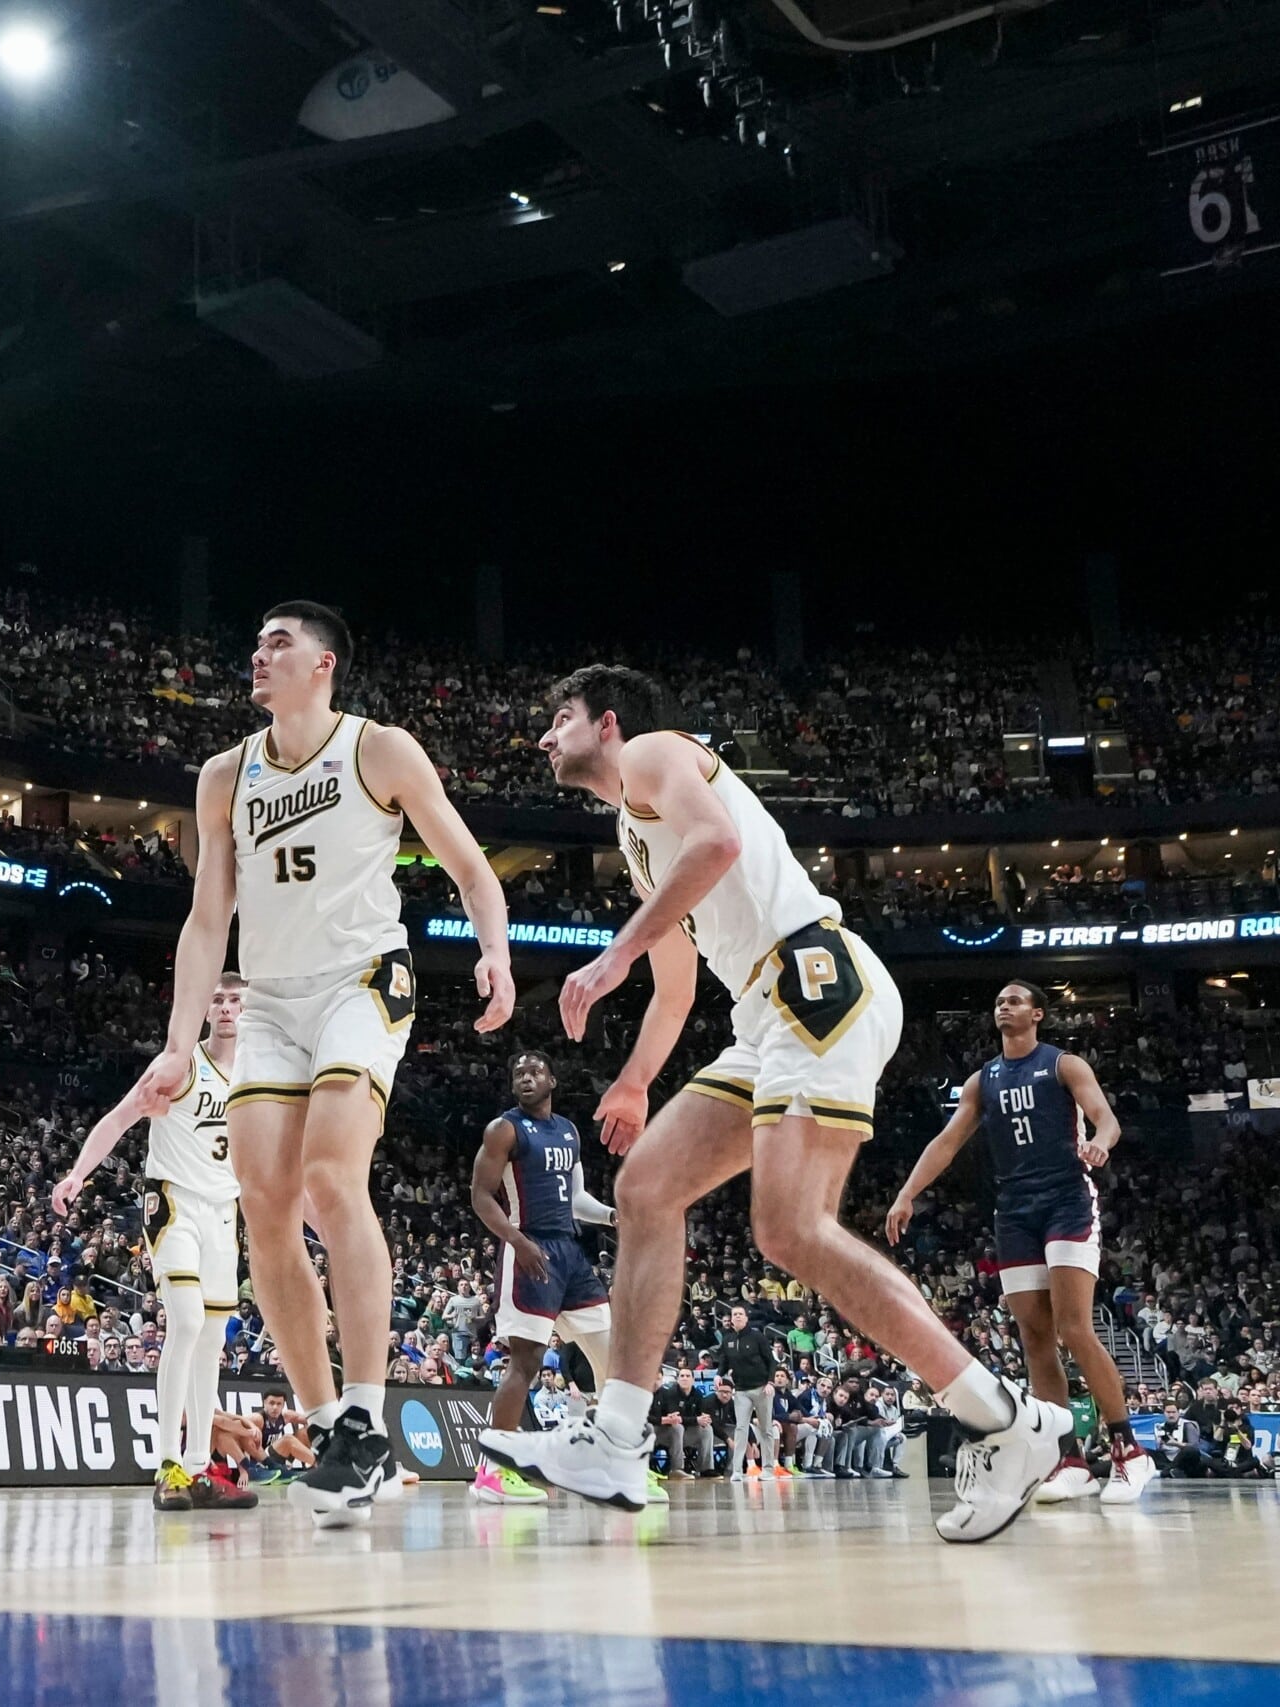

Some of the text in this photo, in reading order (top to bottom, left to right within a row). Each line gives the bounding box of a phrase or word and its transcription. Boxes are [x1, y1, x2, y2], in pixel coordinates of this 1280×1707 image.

[1190, 157, 1261, 244] 61
[246, 777, 342, 837] Purdue
[274, 845, 317, 884] 15
[427, 919, 613, 946] #MAHMADNESS
[1048, 926, 1117, 946] FIRST
[1141, 921, 1235, 944] SECOND
[1240, 916, 1280, 938] ROU
[41, 947, 56, 960] C7
[793, 946, 839, 1001] P
[1144, 984, 1170, 996] C10
[57, 1071, 81, 1088] 106
[194, 1091, 227, 1119] Pur
[999, 1085, 1036, 1115] FDU
[1011, 1116, 1035, 1146] 21
[544, 1147, 574, 1171] FDU
[556, 1174, 569, 1202] 2
[144, 1191, 160, 1226] P
[53, 1339, 80, 1355] POSS.
[125, 1387, 161, 1470] 5
[409, 1431, 443, 1451] NCAA
[455, 1427, 483, 1441] TIT
